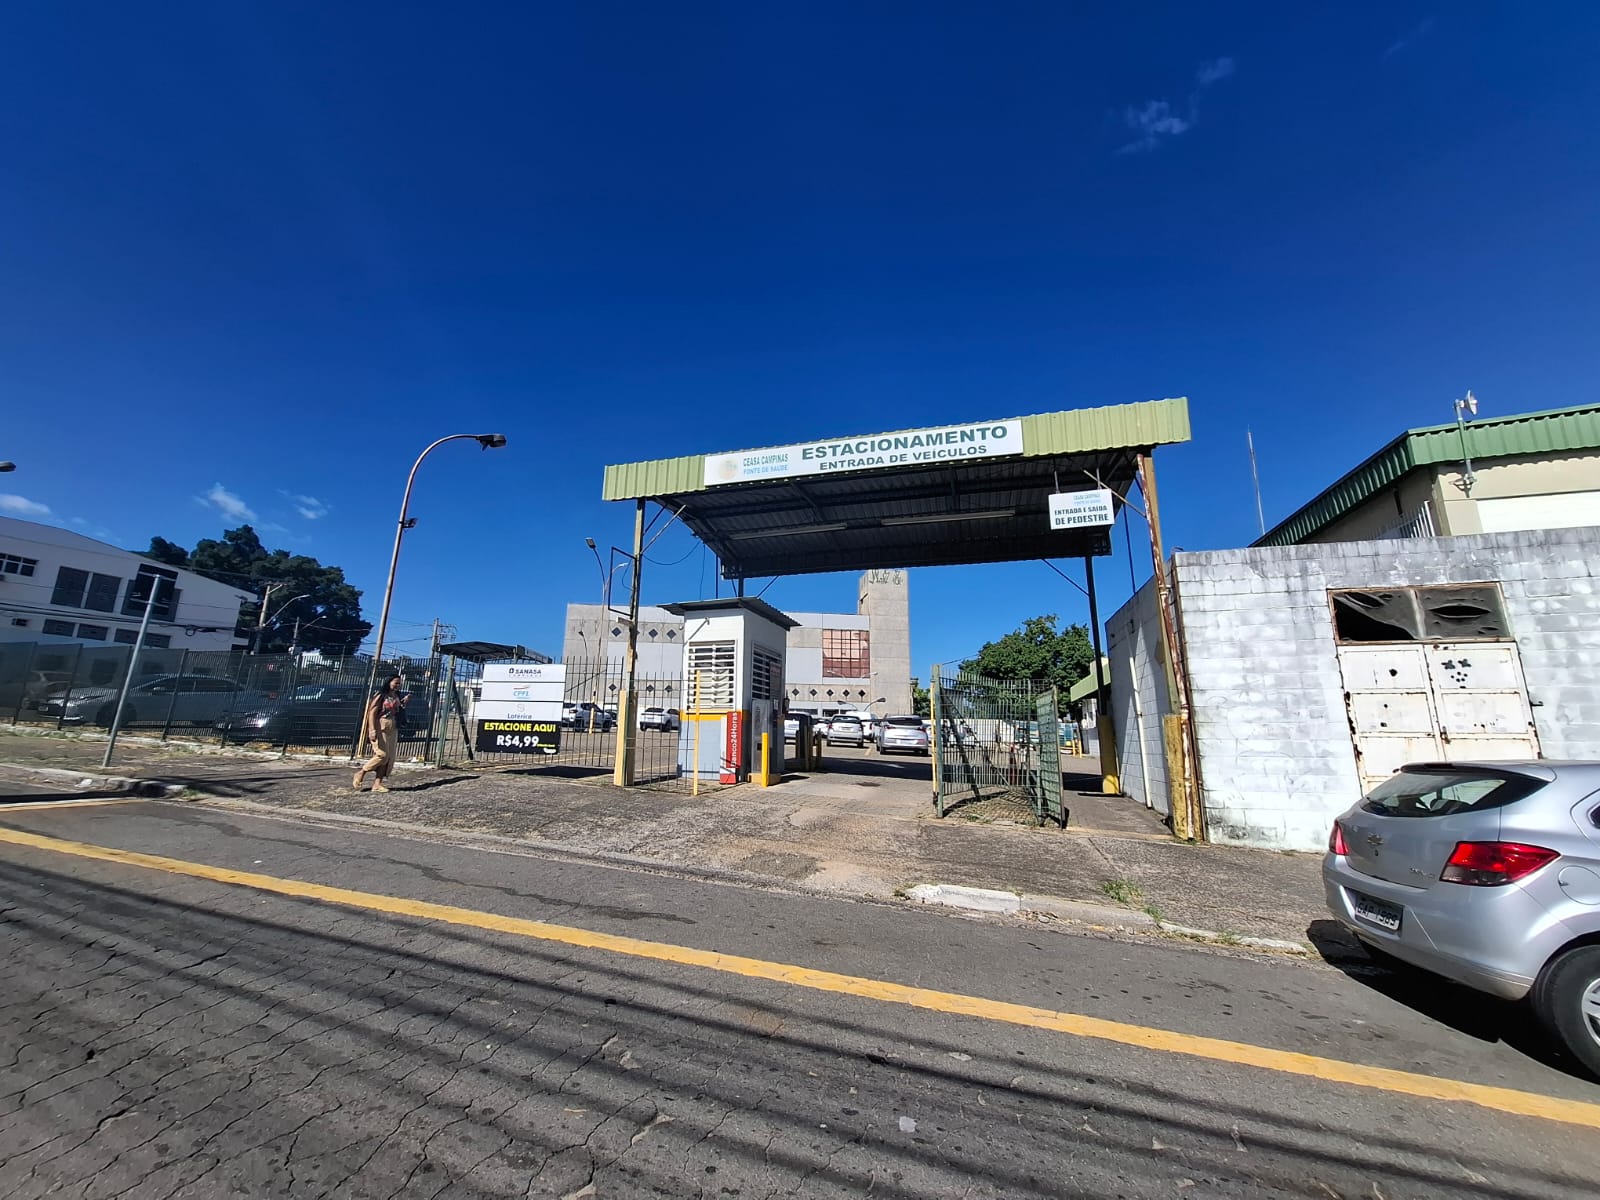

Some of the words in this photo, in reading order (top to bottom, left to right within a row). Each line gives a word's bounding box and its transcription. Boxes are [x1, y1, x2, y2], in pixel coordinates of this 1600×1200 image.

[802, 425, 1008, 460] ESTACIONAMENTO
[743, 456, 760, 467] CEASA
[761, 453, 788, 465] CAMPINAS
[819, 456, 884, 471] ENTRADA
[889, 453, 908, 463] DE
[913, 445, 988, 461] VEÍCULOS
[1054, 507, 1082, 516] ENTRADA
[1055, 517, 1066, 525] DE
[1067, 513, 1109, 524] PEDESTRE
[484, 722, 532, 731] ESTACIONE
[533, 723, 556, 732] AQUI
[496, 734, 540, 748] R$4,99
